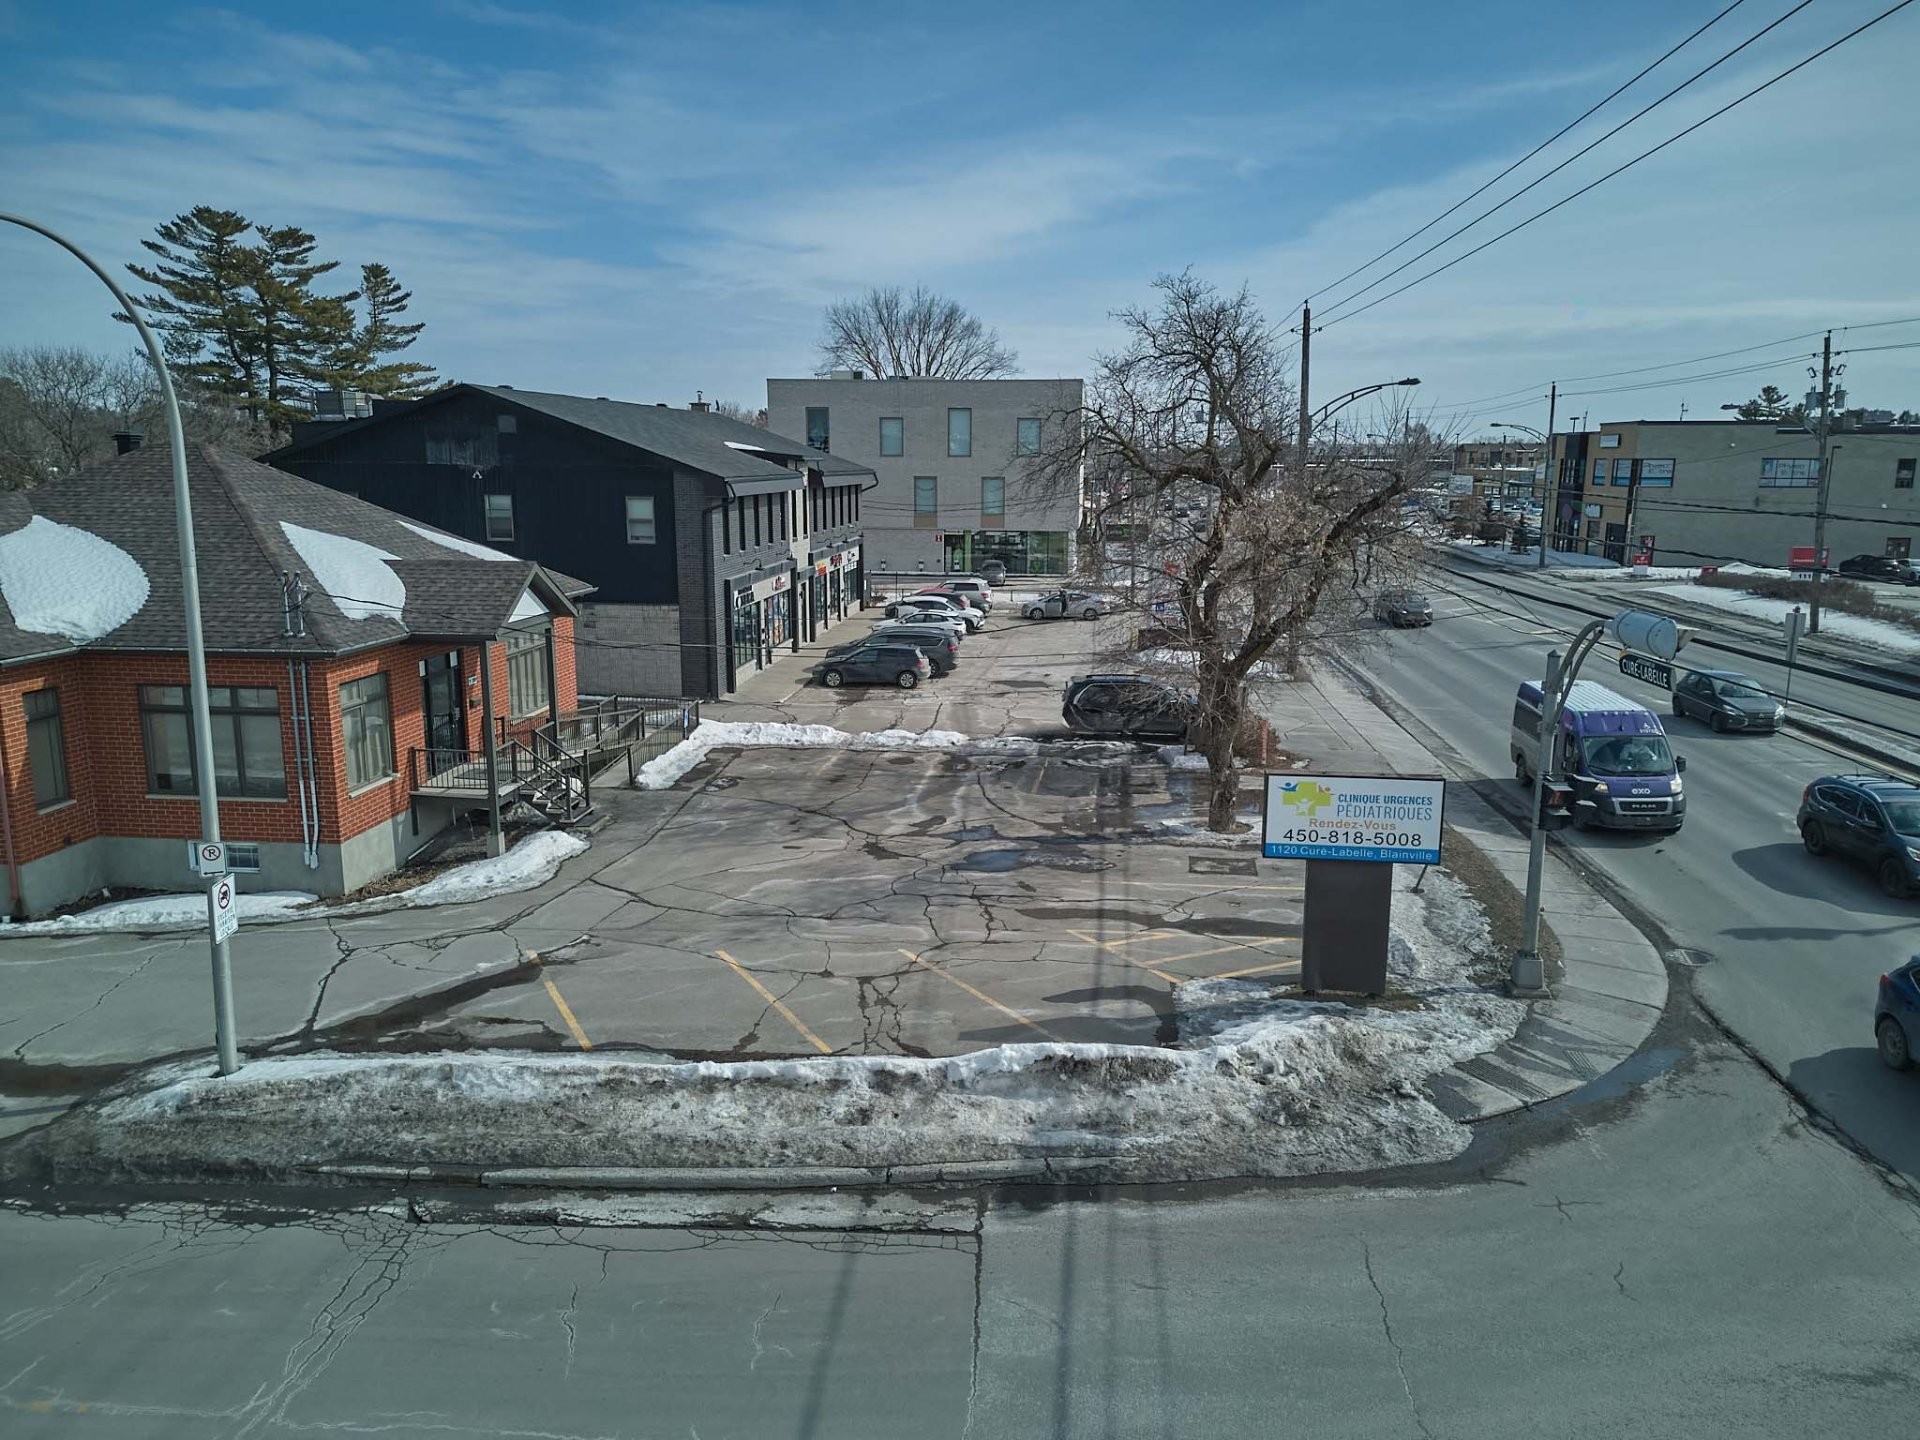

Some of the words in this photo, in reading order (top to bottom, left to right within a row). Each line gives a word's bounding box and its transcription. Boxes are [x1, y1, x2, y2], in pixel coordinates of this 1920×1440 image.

[1622, 659, 1668, 688] CURÉ-LABELLE
[1338, 793, 1381, 804] CLINIQUE
[1383, 795, 1433, 806] URGENCES
[1337, 802, 1432, 821] PÉDIATRIQUES
[1309, 818, 1396, 831] Rendez-Vous
[1283, 829, 1422, 847] 450-818-5008
[1272, 845, 1298, 855] 1120
[1380, 850, 1433, 861] Blainville
